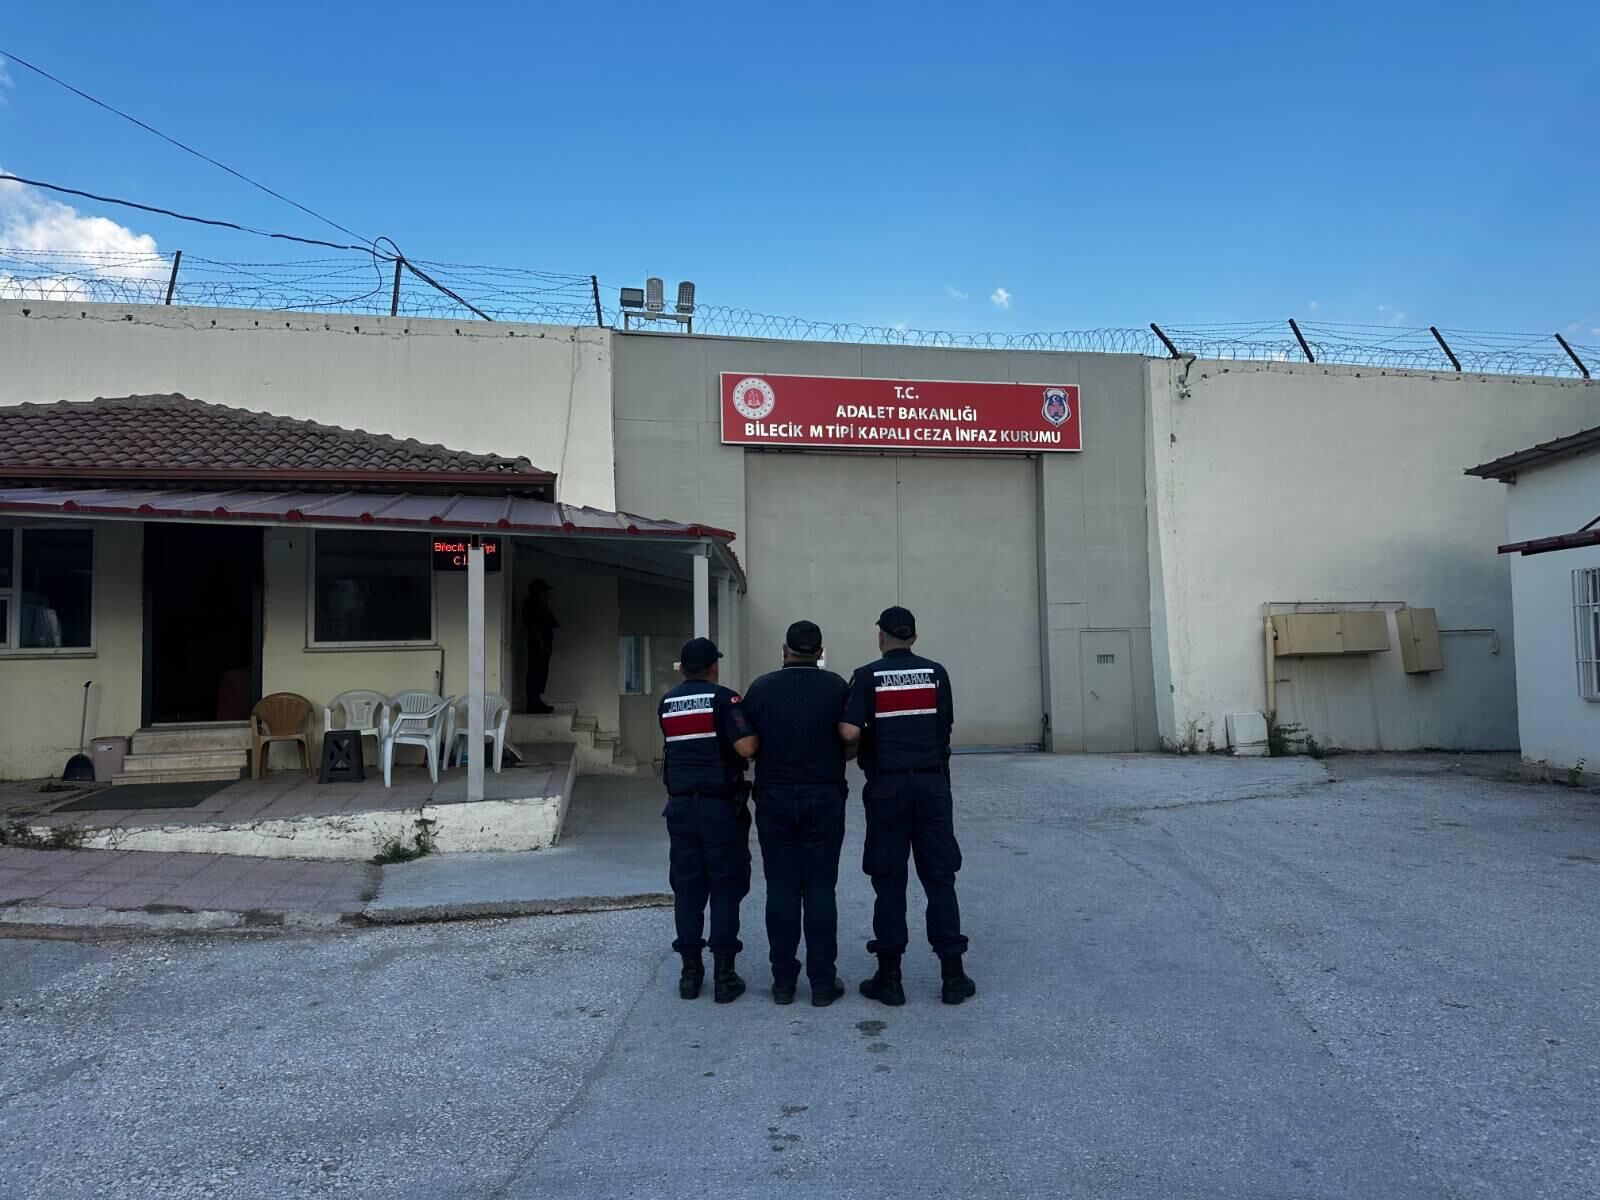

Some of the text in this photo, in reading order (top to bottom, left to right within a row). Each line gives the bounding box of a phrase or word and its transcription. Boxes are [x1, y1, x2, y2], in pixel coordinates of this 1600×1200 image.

[894, 386, 919, 399] T.C.
[836, 404, 977, 421] ADALET BAKANLIĞI
[745, 420, 1061, 443] BİLECİK M TİPİ KAPALI CEZA İNFAZ KURUMU
[881, 673, 931, 687] JANDARMA
[668, 697, 711, 713] JANDARMA
